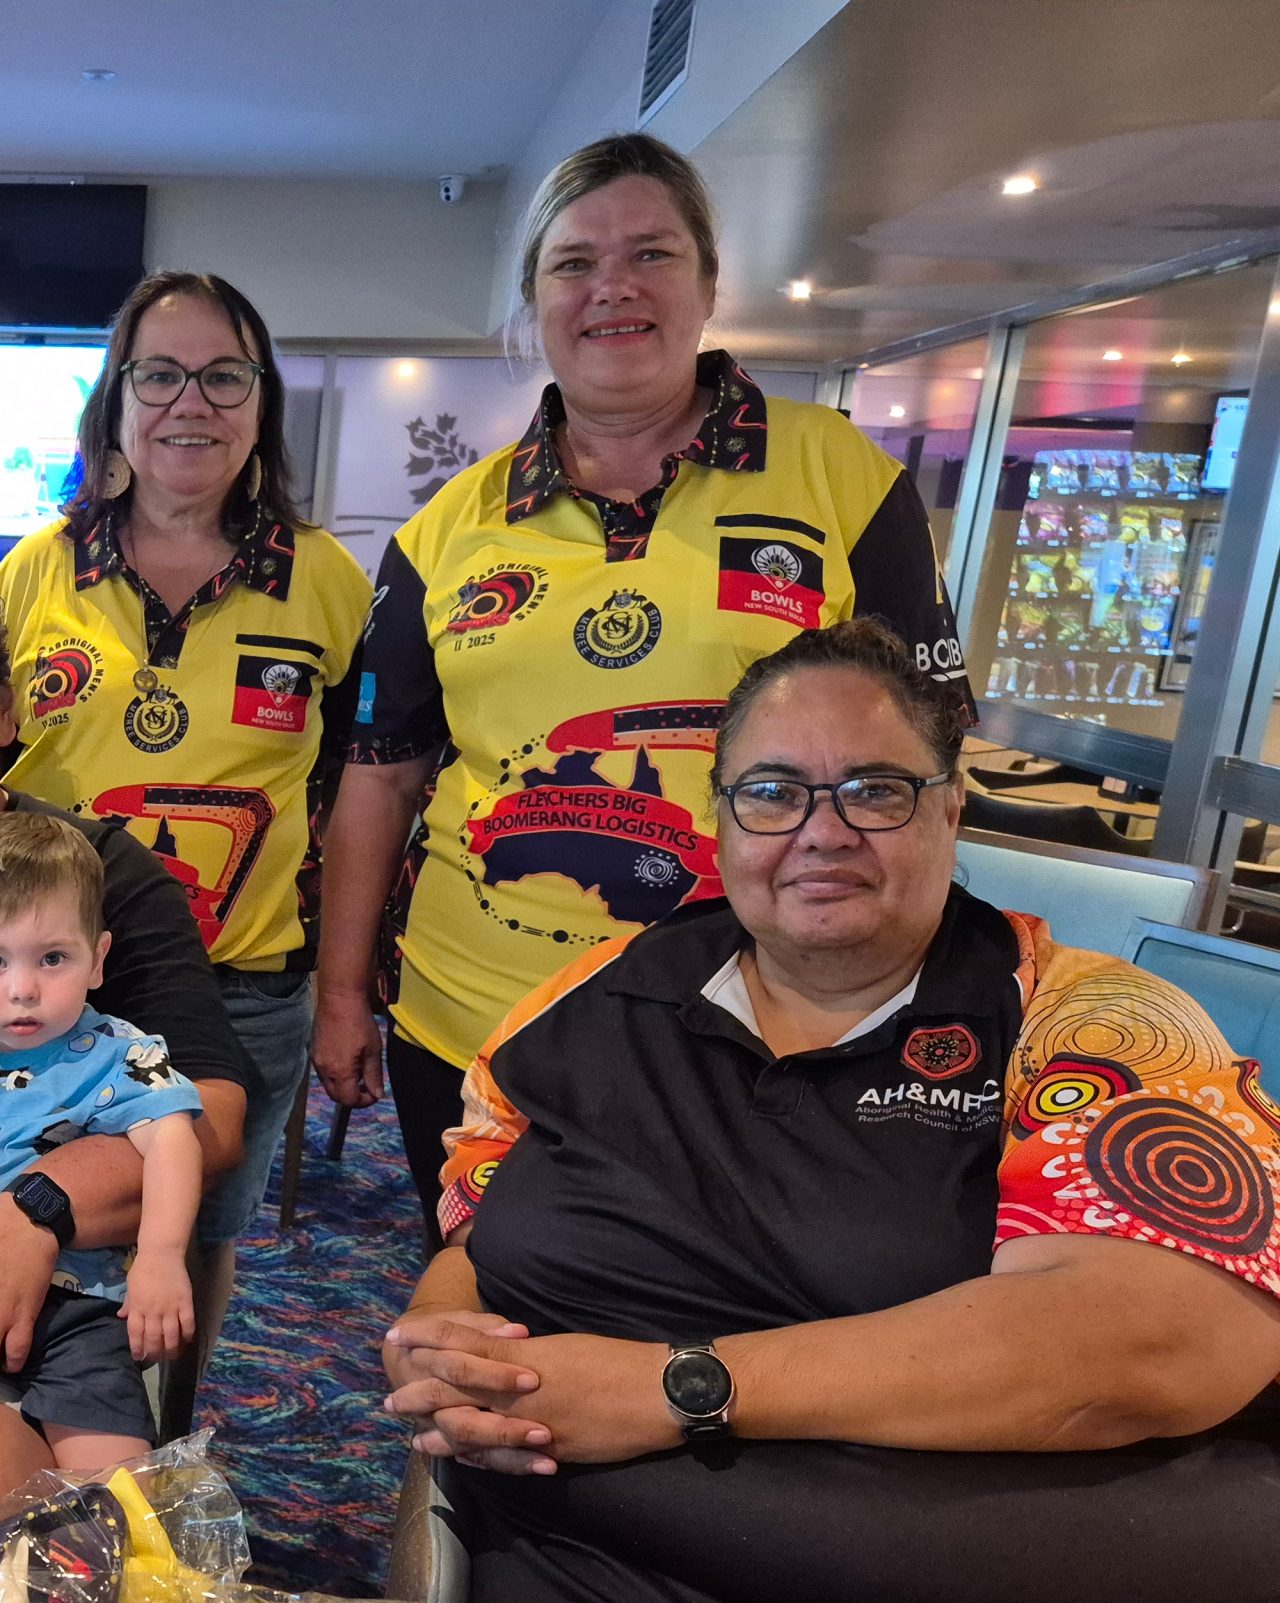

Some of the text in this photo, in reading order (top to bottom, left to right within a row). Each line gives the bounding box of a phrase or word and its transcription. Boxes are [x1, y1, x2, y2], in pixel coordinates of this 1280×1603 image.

[751, 590, 803, 613] BOWLS
[764, 604, 788, 615] SOUTH
[467, 632, 496, 649] 2025
[575, 608, 660, 668] MOREE SERVICES CLUB
[257, 706, 294, 722] BOWLS
[134, 736, 180, 752] SERVICES
[612, 792, 647, 815] BIG
[483, 810, 698, 851] BOOMERANG LOGISTICS
[855, 1102, 911, 1114] Aboriginal
[914, 1103, 952, 1119] Health
[858, 1111, 911, 1122] Research
[914, 1113, 958, 1131] Council
[974, 1114, 1001, 1129] NSW
